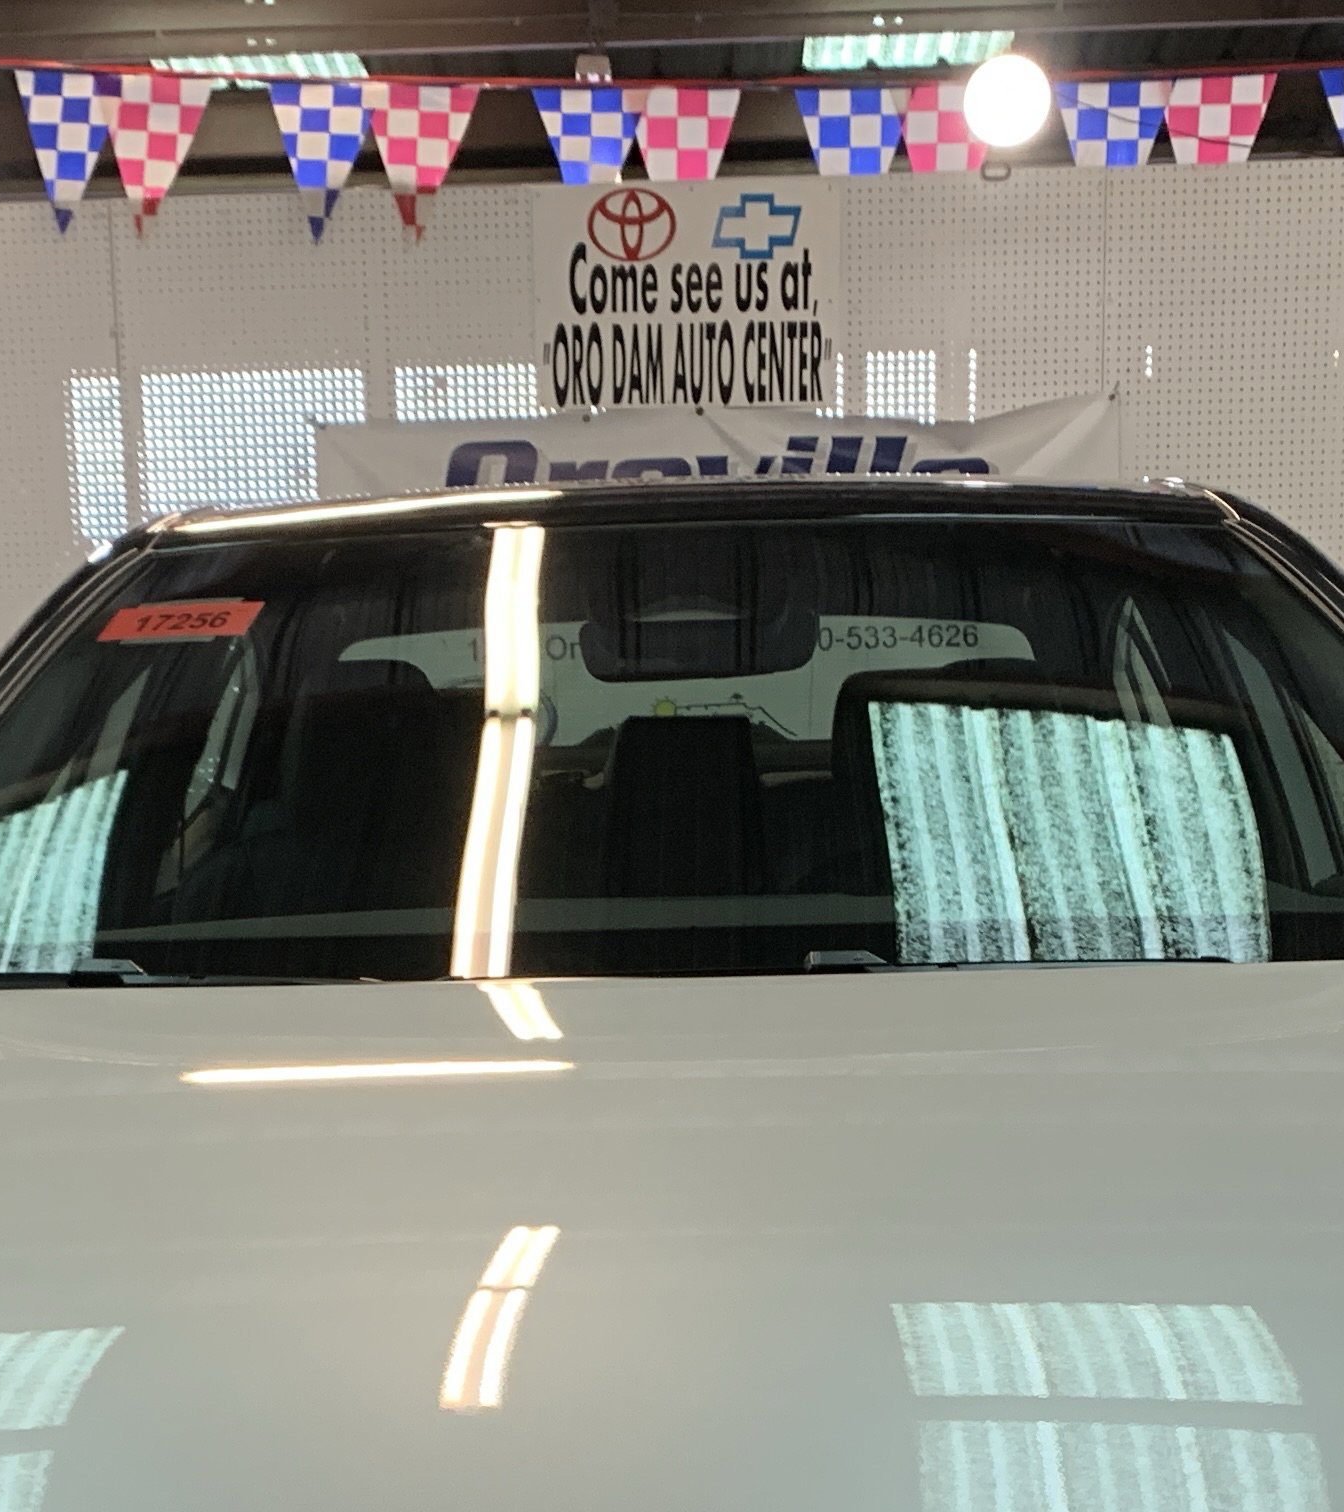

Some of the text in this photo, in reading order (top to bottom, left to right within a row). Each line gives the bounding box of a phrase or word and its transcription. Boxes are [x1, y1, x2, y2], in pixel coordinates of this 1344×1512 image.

[568, 241, 658, 315] Come
[670, 261, 723, 314] see
[735, 261, 769, 313] us
[612, 322, 665, 405] DAM
[672, 319, 735, 406] AUTO
[136, 611, 231, 632] 17256
[817, 623, 980, 651] 0-533-4626
